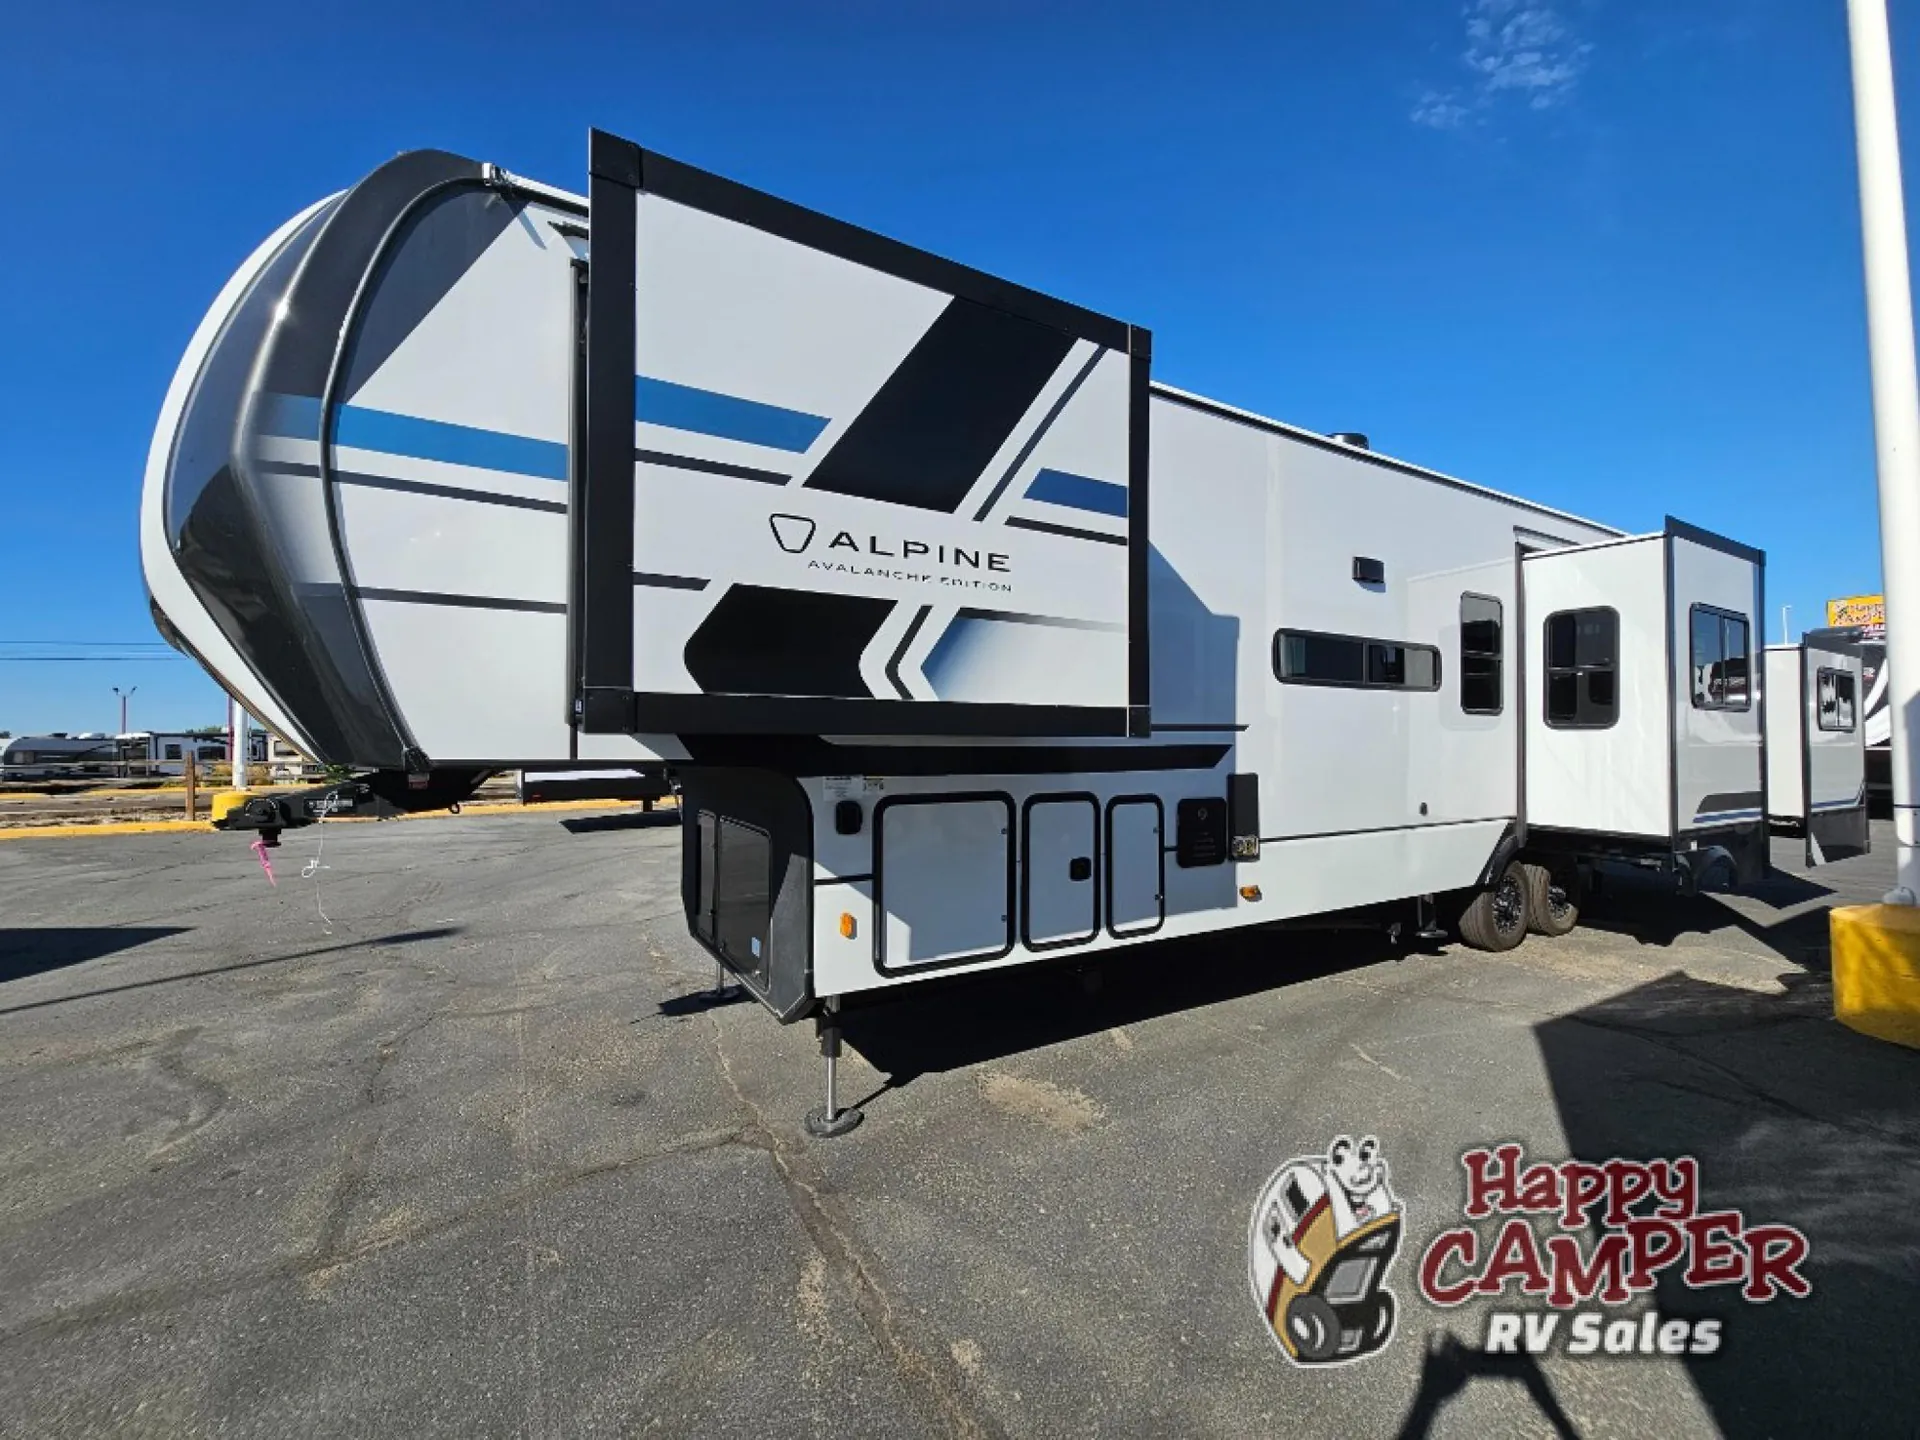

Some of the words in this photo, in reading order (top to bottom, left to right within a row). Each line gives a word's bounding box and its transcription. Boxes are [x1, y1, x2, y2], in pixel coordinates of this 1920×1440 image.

[829, 531, 1011, 572] ALPINE
[808, 560, 932, 583] AVALANCHE
[940, 576, 1012, 592] EDITION
